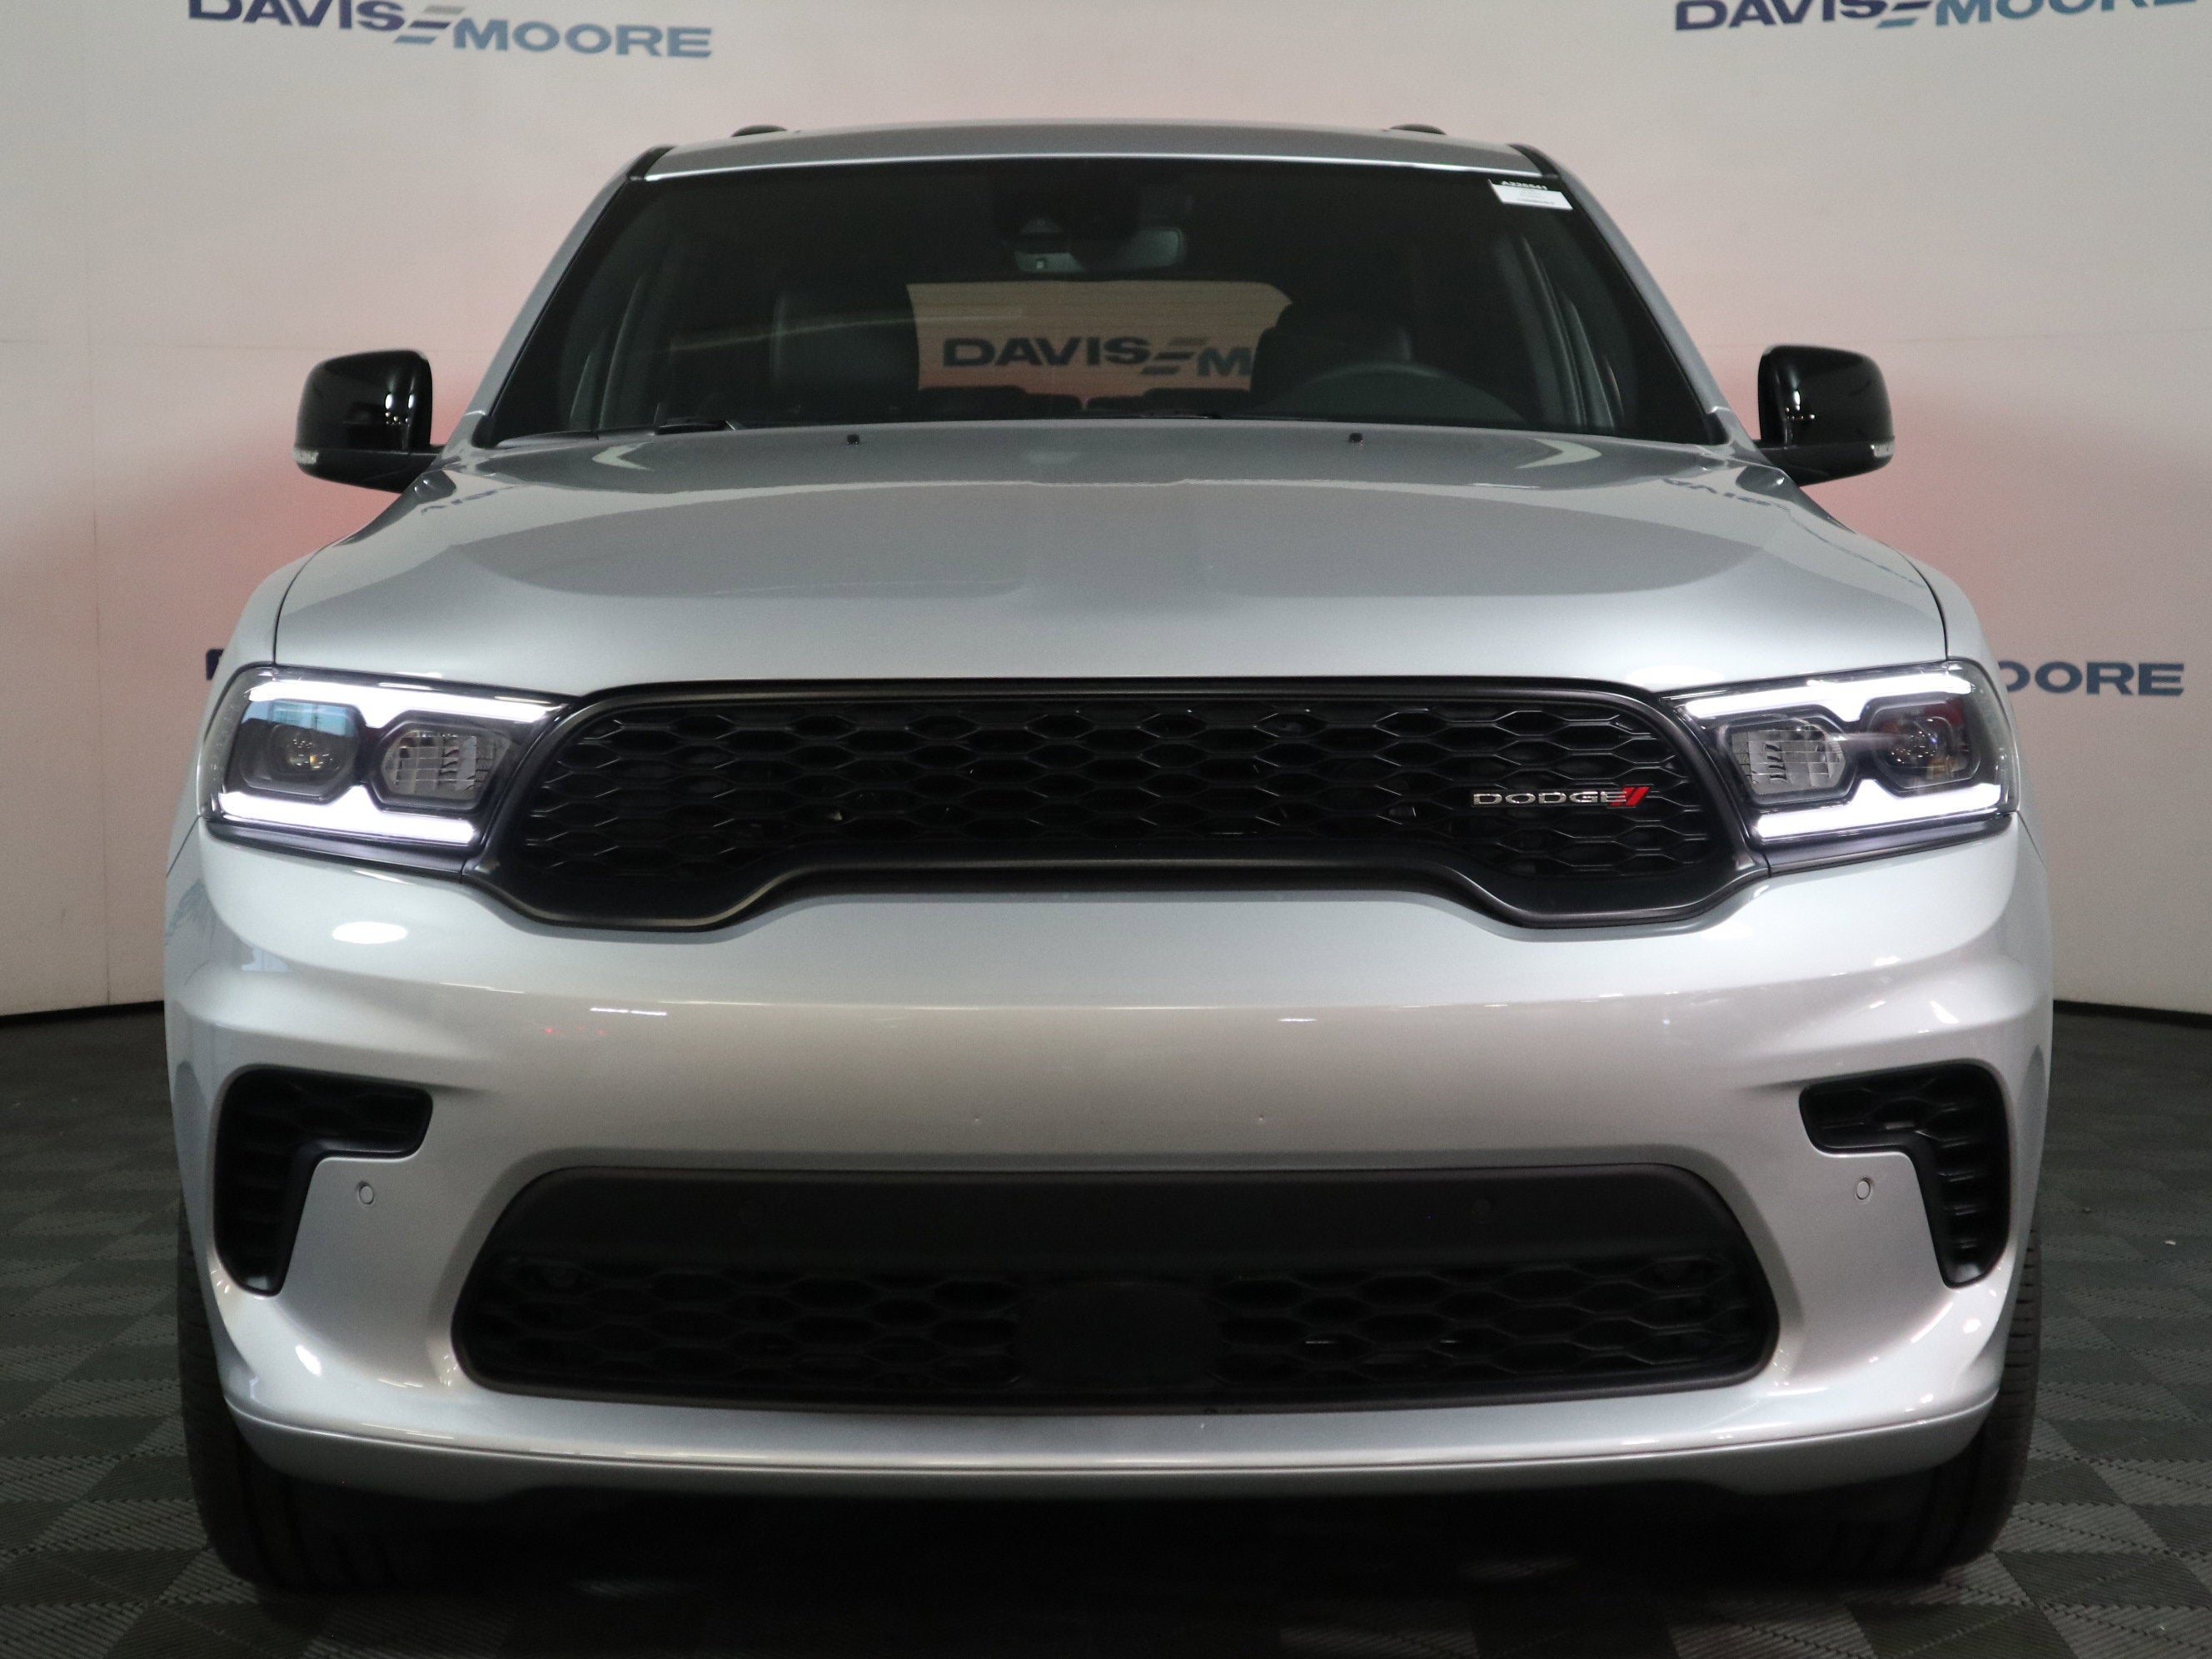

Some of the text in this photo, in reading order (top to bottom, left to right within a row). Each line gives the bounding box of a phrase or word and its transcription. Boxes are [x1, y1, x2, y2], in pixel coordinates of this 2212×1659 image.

[187, 0, 712, 57] DAVIS MOORE
[1674, 0, 1889, 31] DAVIS
[942, 336, 1153, 368] DAVIS
[1997, 660, 2185, 697] OORE
[1472, 790, 1627, 805] DODGE
